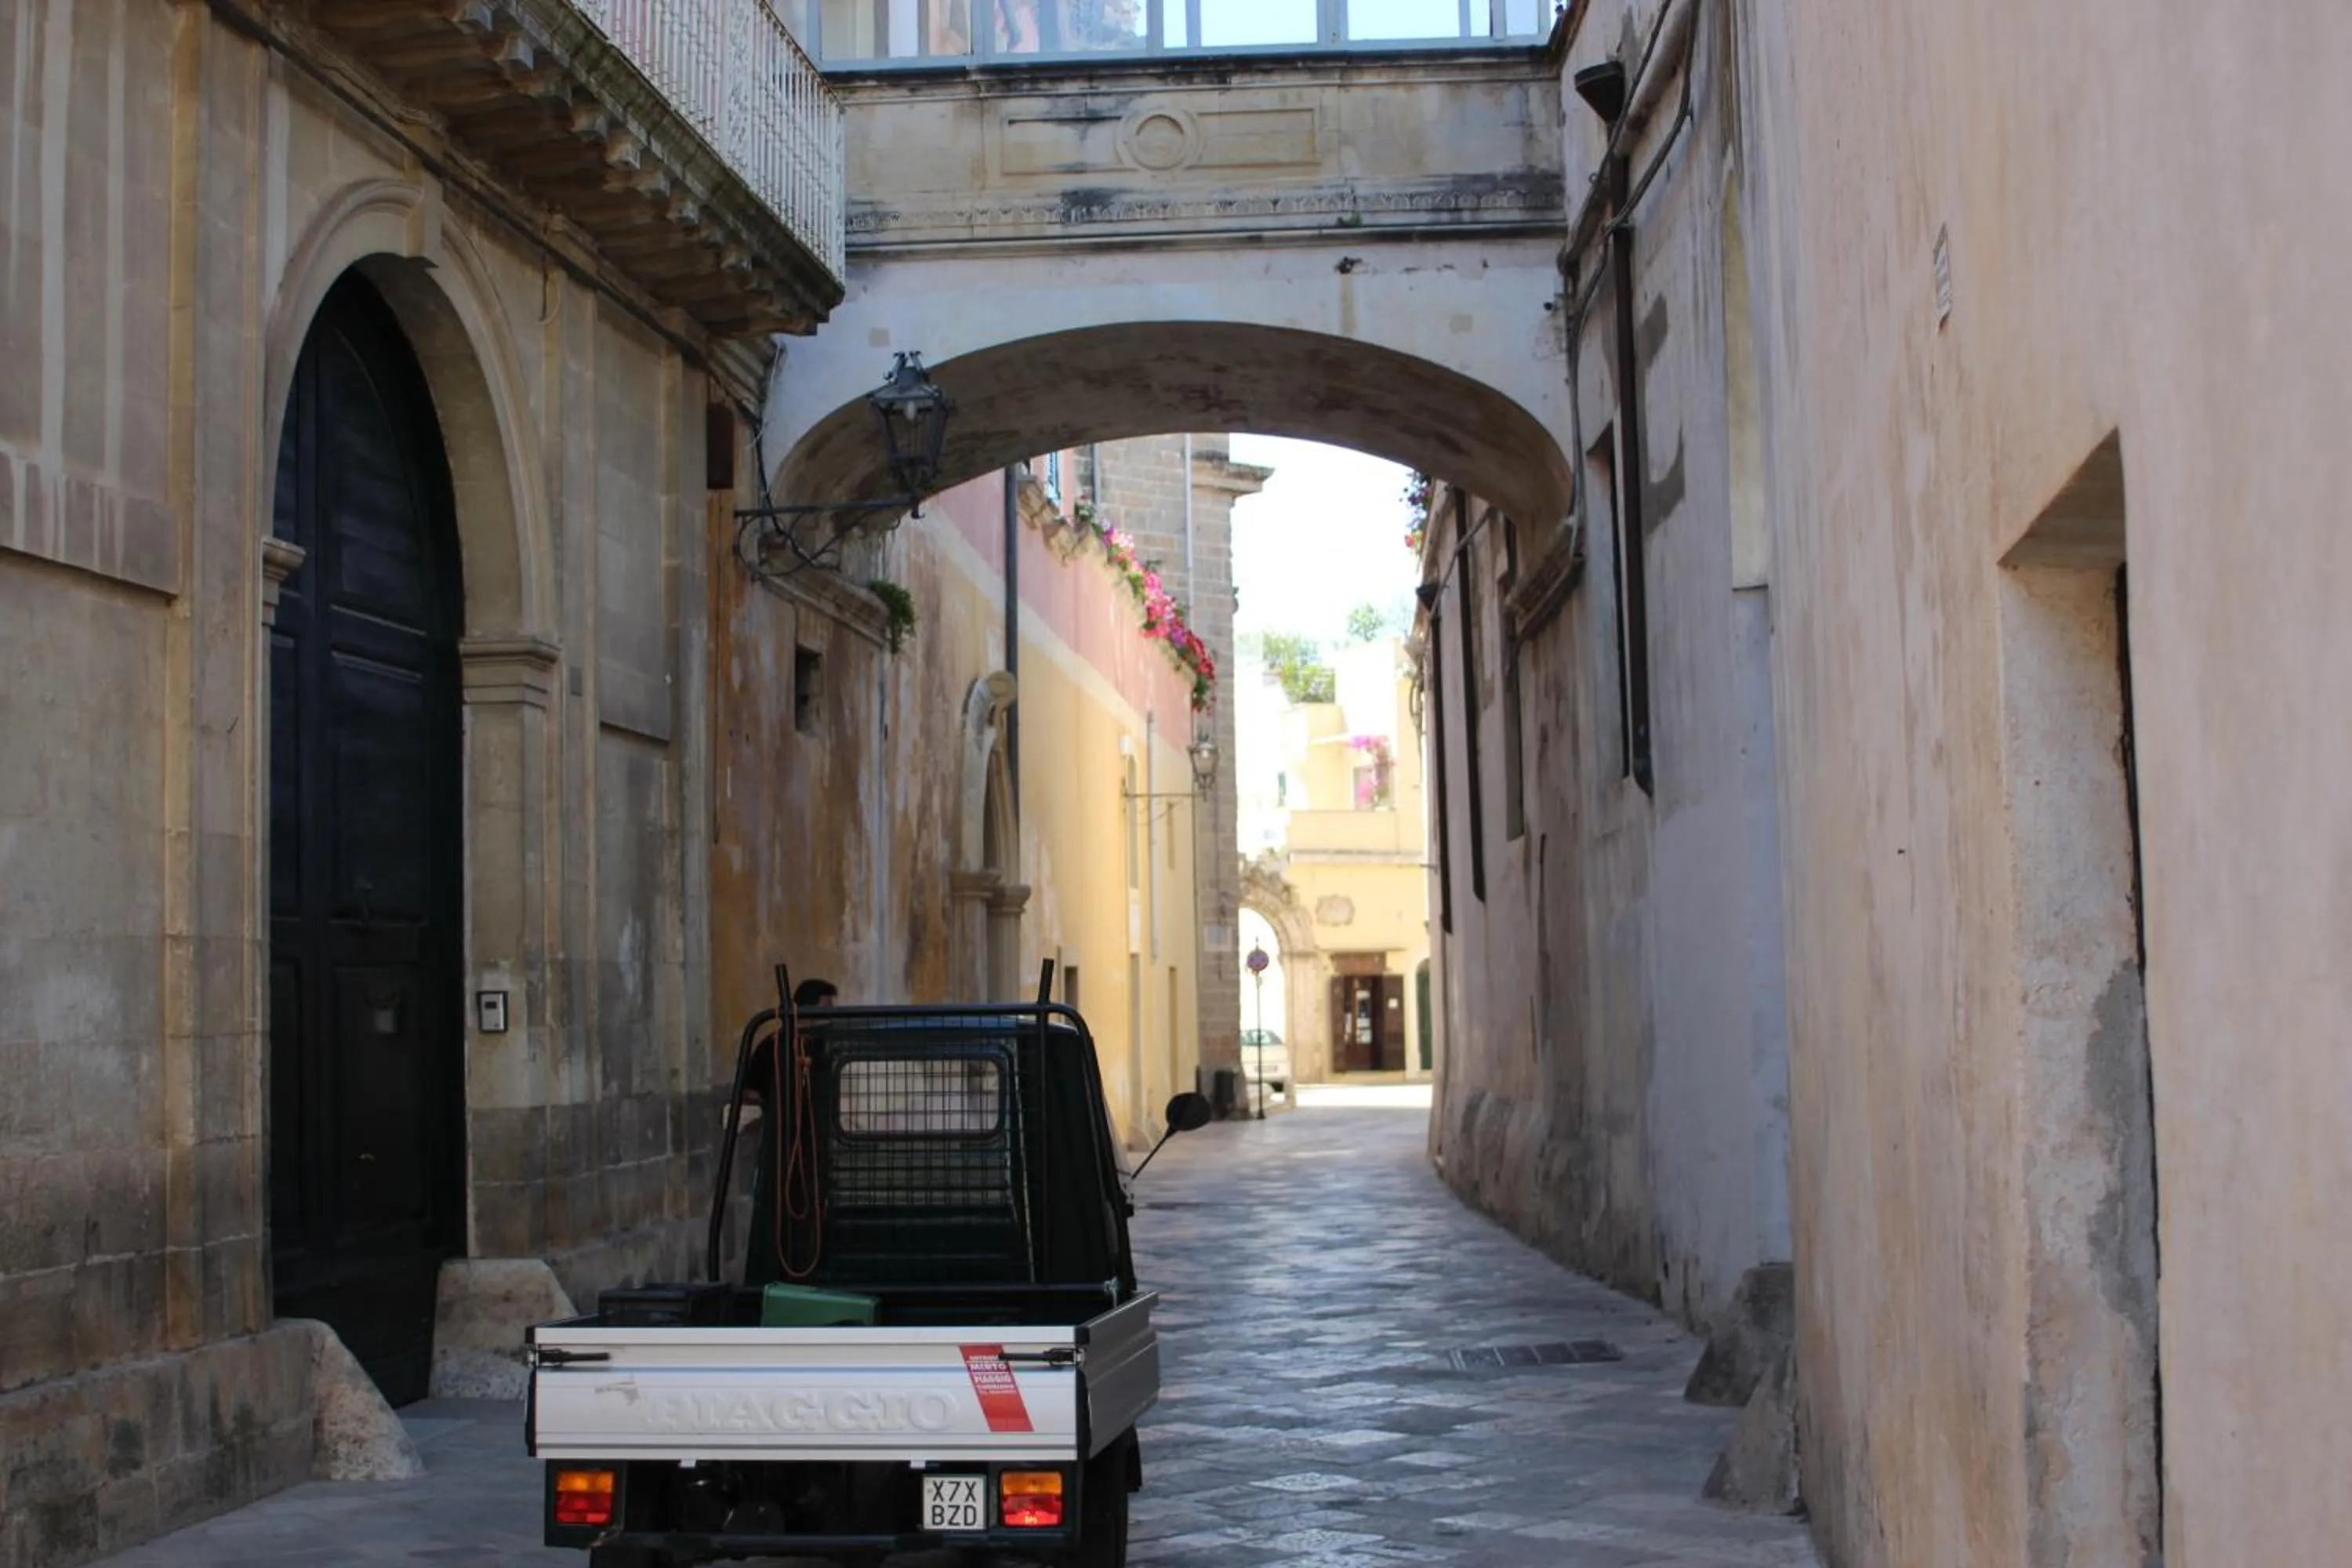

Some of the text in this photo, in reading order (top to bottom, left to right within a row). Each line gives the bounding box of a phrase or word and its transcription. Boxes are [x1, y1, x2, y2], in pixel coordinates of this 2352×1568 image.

[641, 1389, 960, 1432] PIAGGIO
[932, 1480, 976, 1502] X7X
[931, 1504, 977, 1526] BZD
